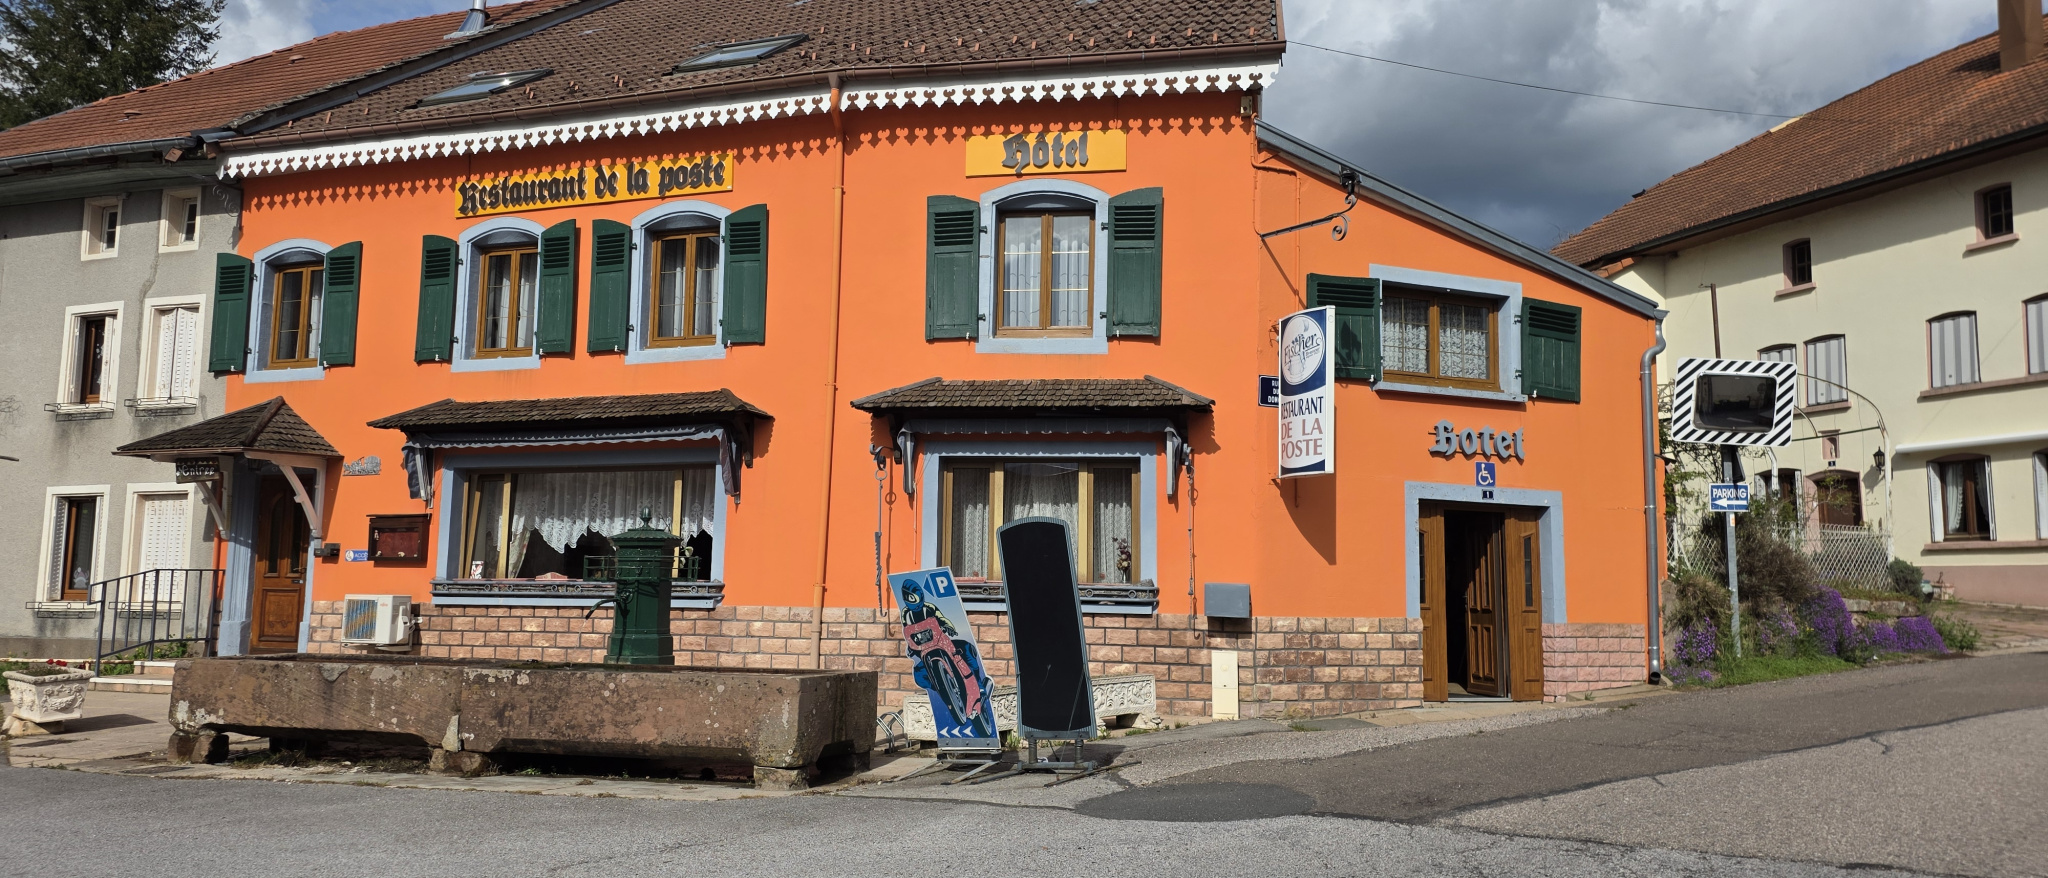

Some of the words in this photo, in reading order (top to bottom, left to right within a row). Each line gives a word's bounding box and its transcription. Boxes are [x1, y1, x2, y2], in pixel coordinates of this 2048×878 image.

[1001, 131, 1089, 175] Hôtel
[457, 167, 588, 215] Restaurant
[594, 165, 619, 199] de
[626, 160, 650, 194] la
[658, 156, 725, 197] poste
[1281, 396, 1324, 420] RESTAURANT
[1281, 421, 1293, 441] DE
[1302, 417, 1324, 437] LA
[1281, 438, 1323, 460] POSTE
[1712, 488, 1747, 498] PARKING
[935, 576, 948, 594] P
